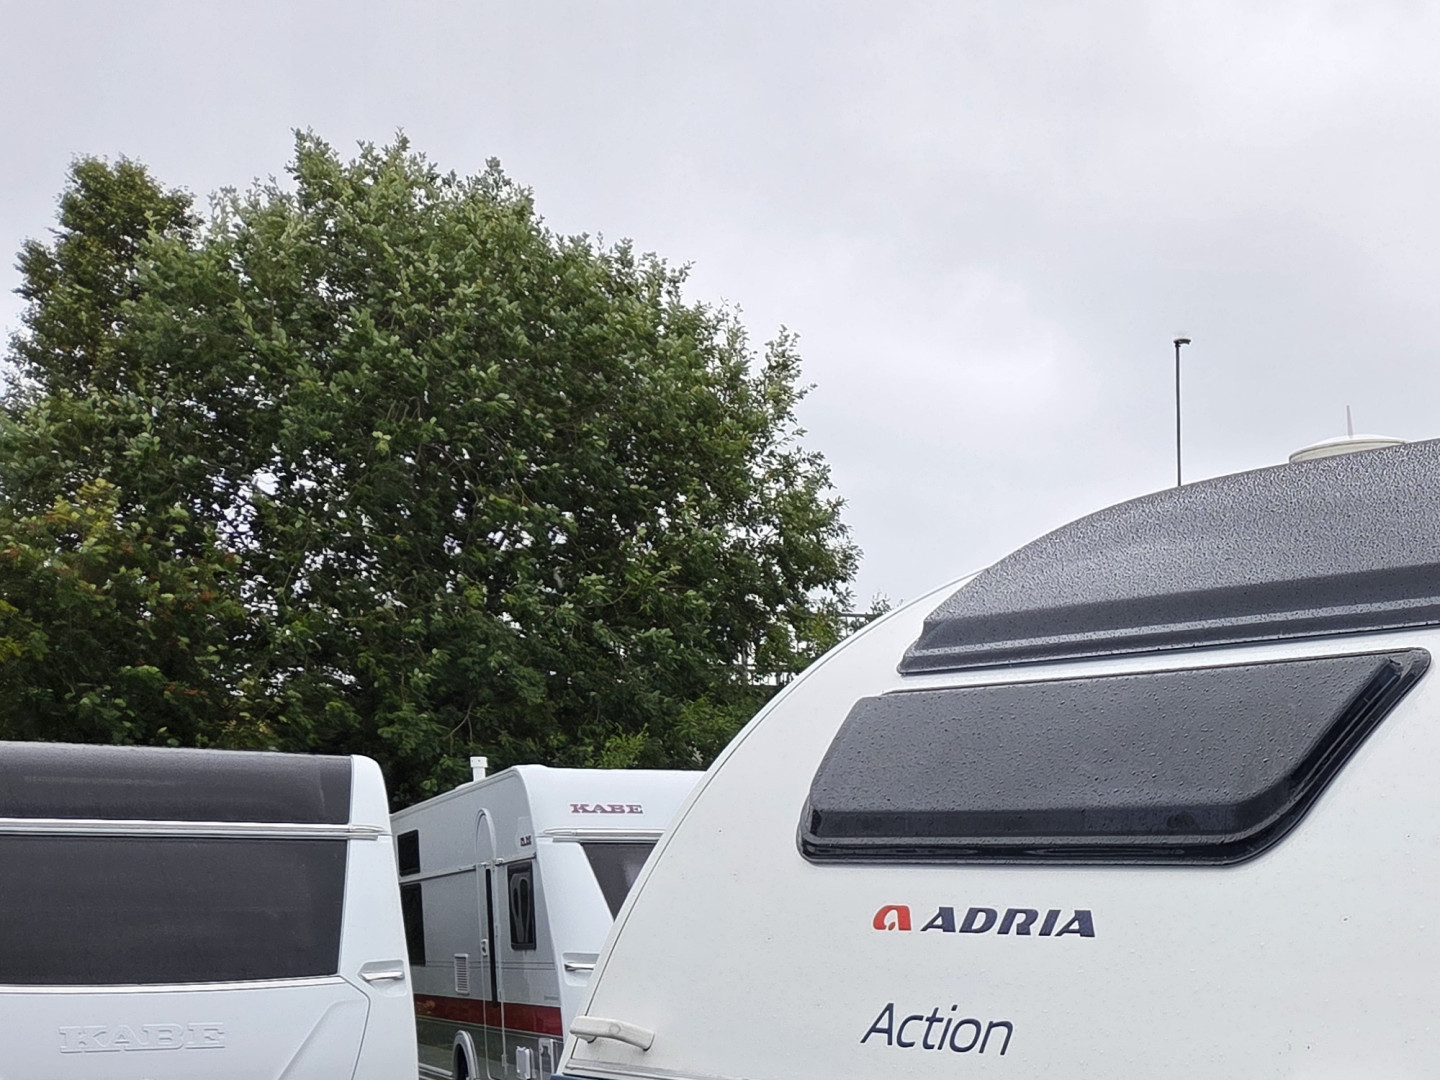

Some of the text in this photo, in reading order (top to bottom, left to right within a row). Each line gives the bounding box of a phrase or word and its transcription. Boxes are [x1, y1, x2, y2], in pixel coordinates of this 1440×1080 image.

[570, 803, 644, 815] KABE
[919, 906, 1096, 938] ADRIA
[58, 1021, 226, 1054] KABE
[859, 1002, 1014, 1056] Action
